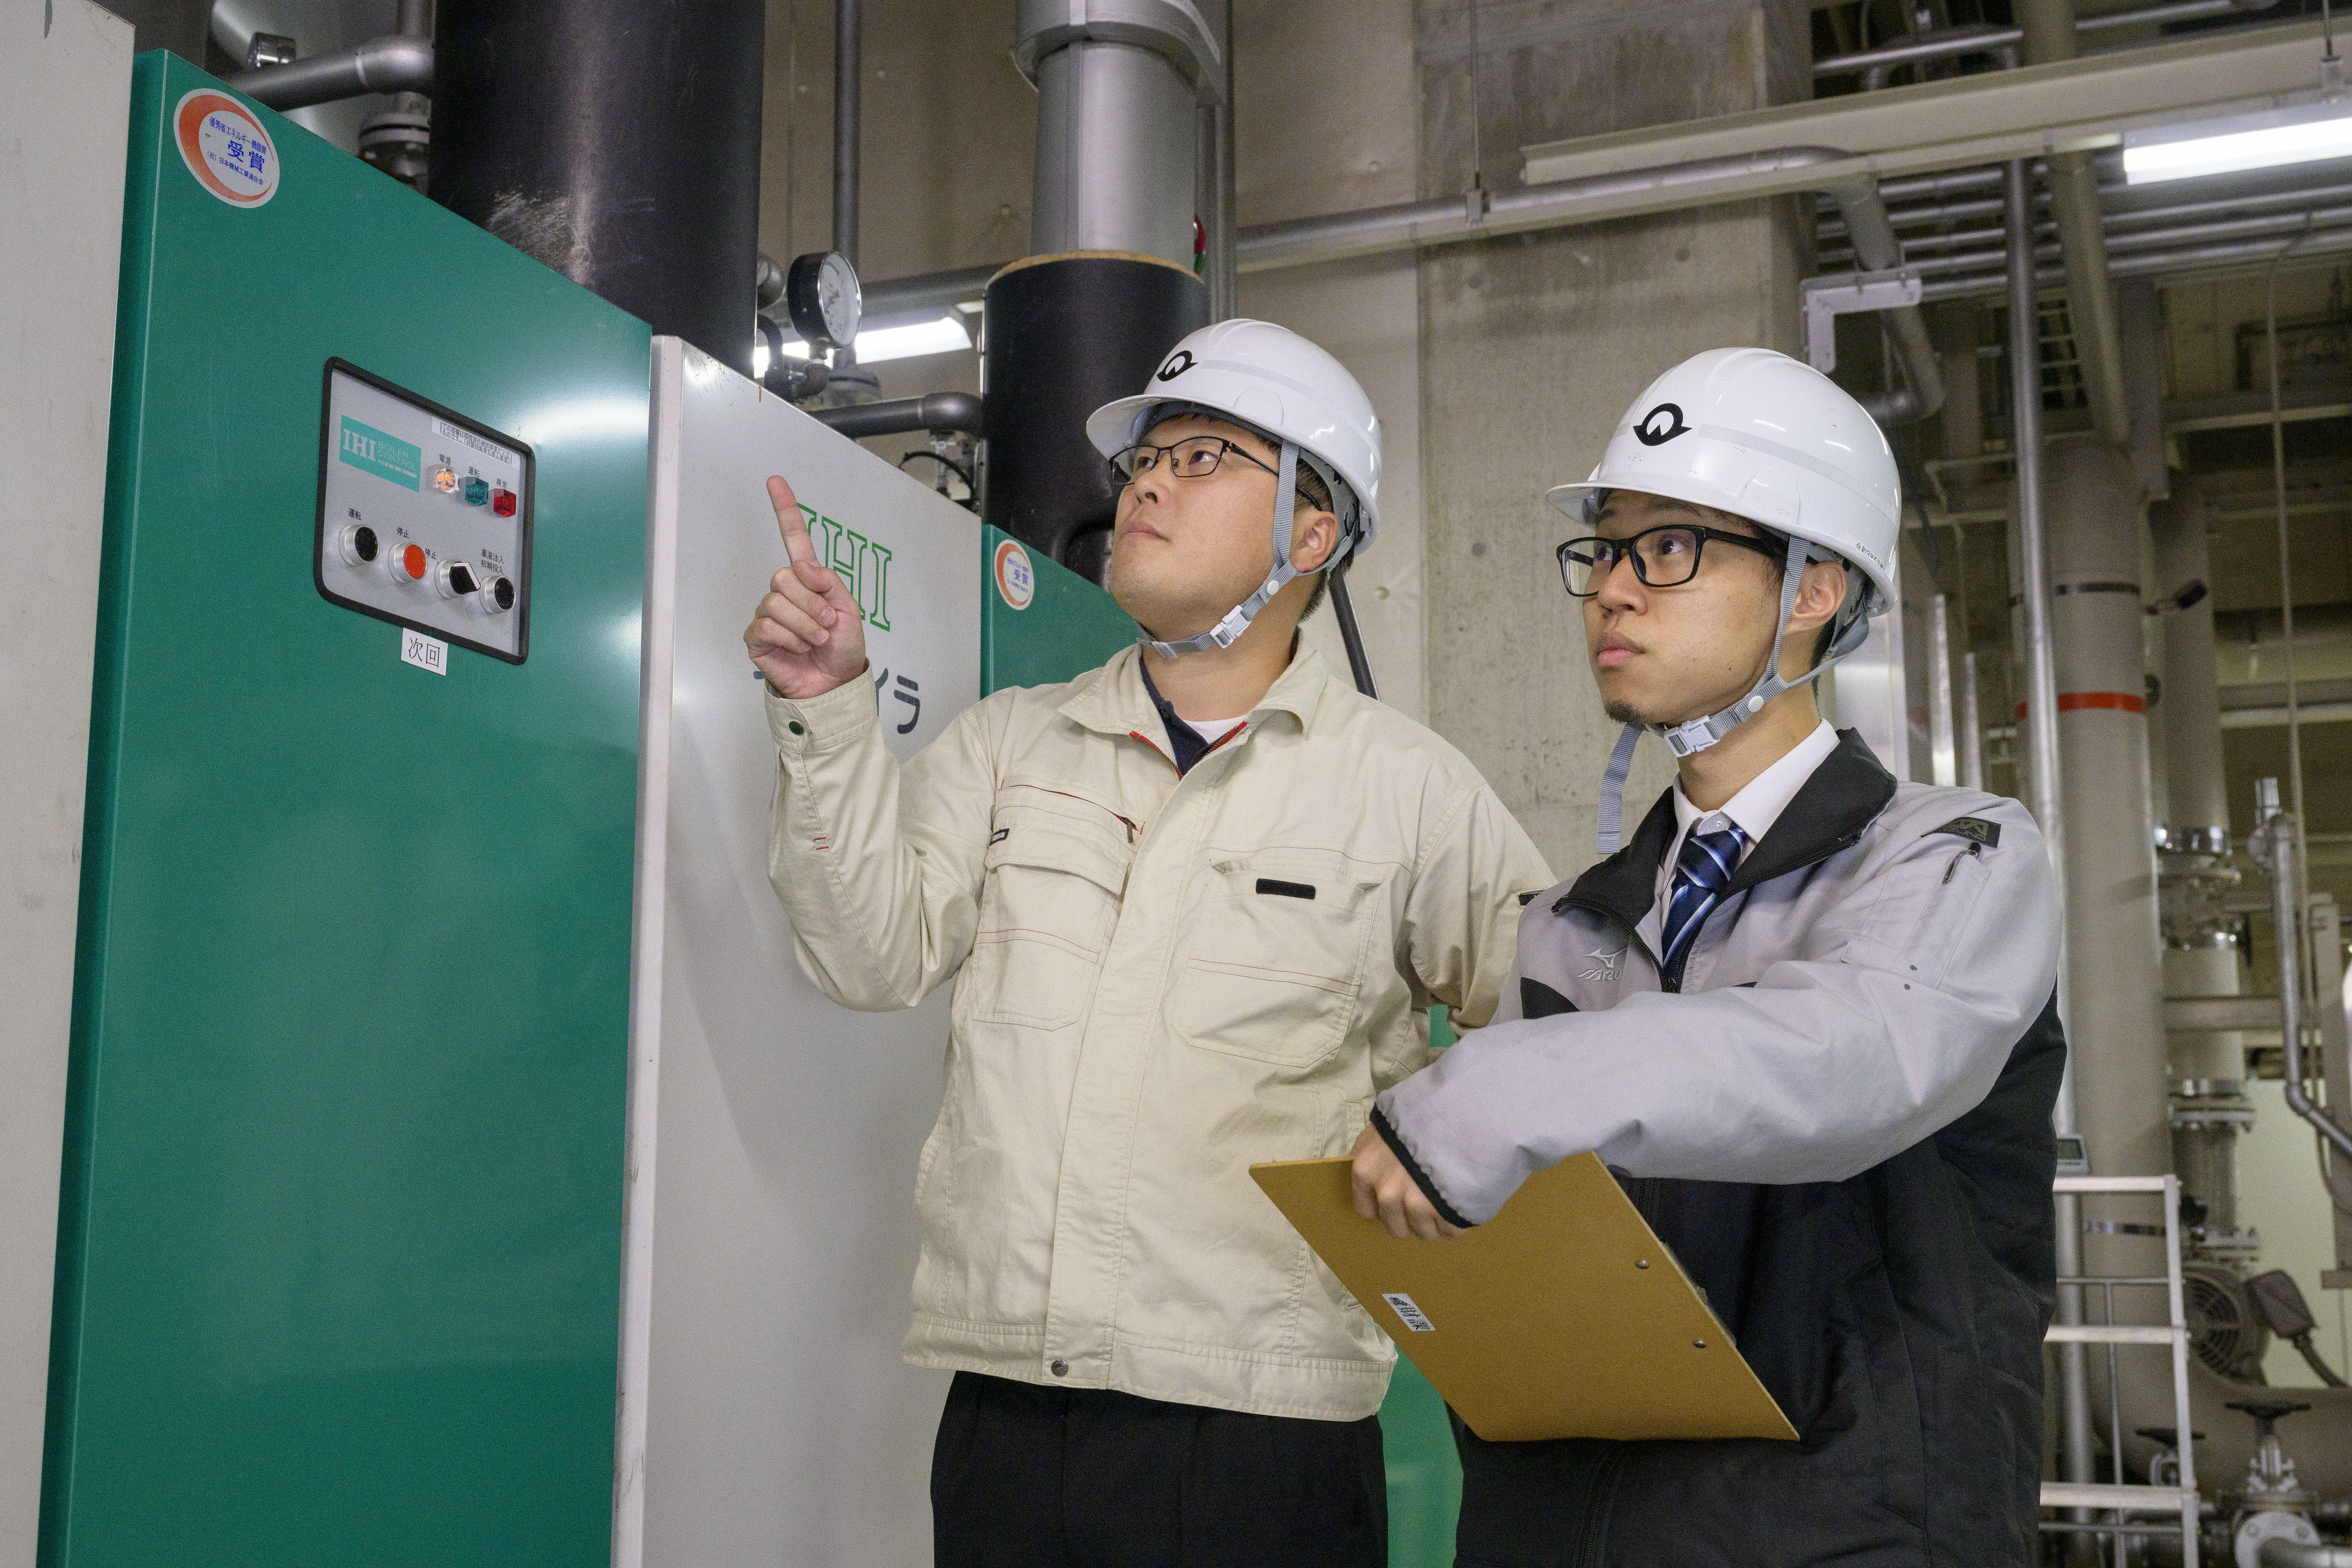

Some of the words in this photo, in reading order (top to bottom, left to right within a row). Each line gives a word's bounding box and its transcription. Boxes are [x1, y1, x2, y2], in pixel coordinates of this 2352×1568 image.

[210, 117, 267, 154] 優秀省エネルギー機器賞
[228, 140, 265, 173] 受賞
[343, 428, 376, 461] IHI
[378, 441, 408, 459] BOILER
[378, 449, 417, 471] CONTROL
[439, 454, 451, 466] 電源
[468, 466, 480, 478] 運転
[495, 478, 507, 489] 異常
[348, 508, 361, 520] 運転
[397, 526, 409, 538] 停止
[425, 548, 437, 559] 停止
[481, 549, 504, 564] 薬液注入
[481, 559, 504, 574] 初期投入
[408, 637, 440, 668] 次回
[1576, 969, 1624, 980] MIZU
